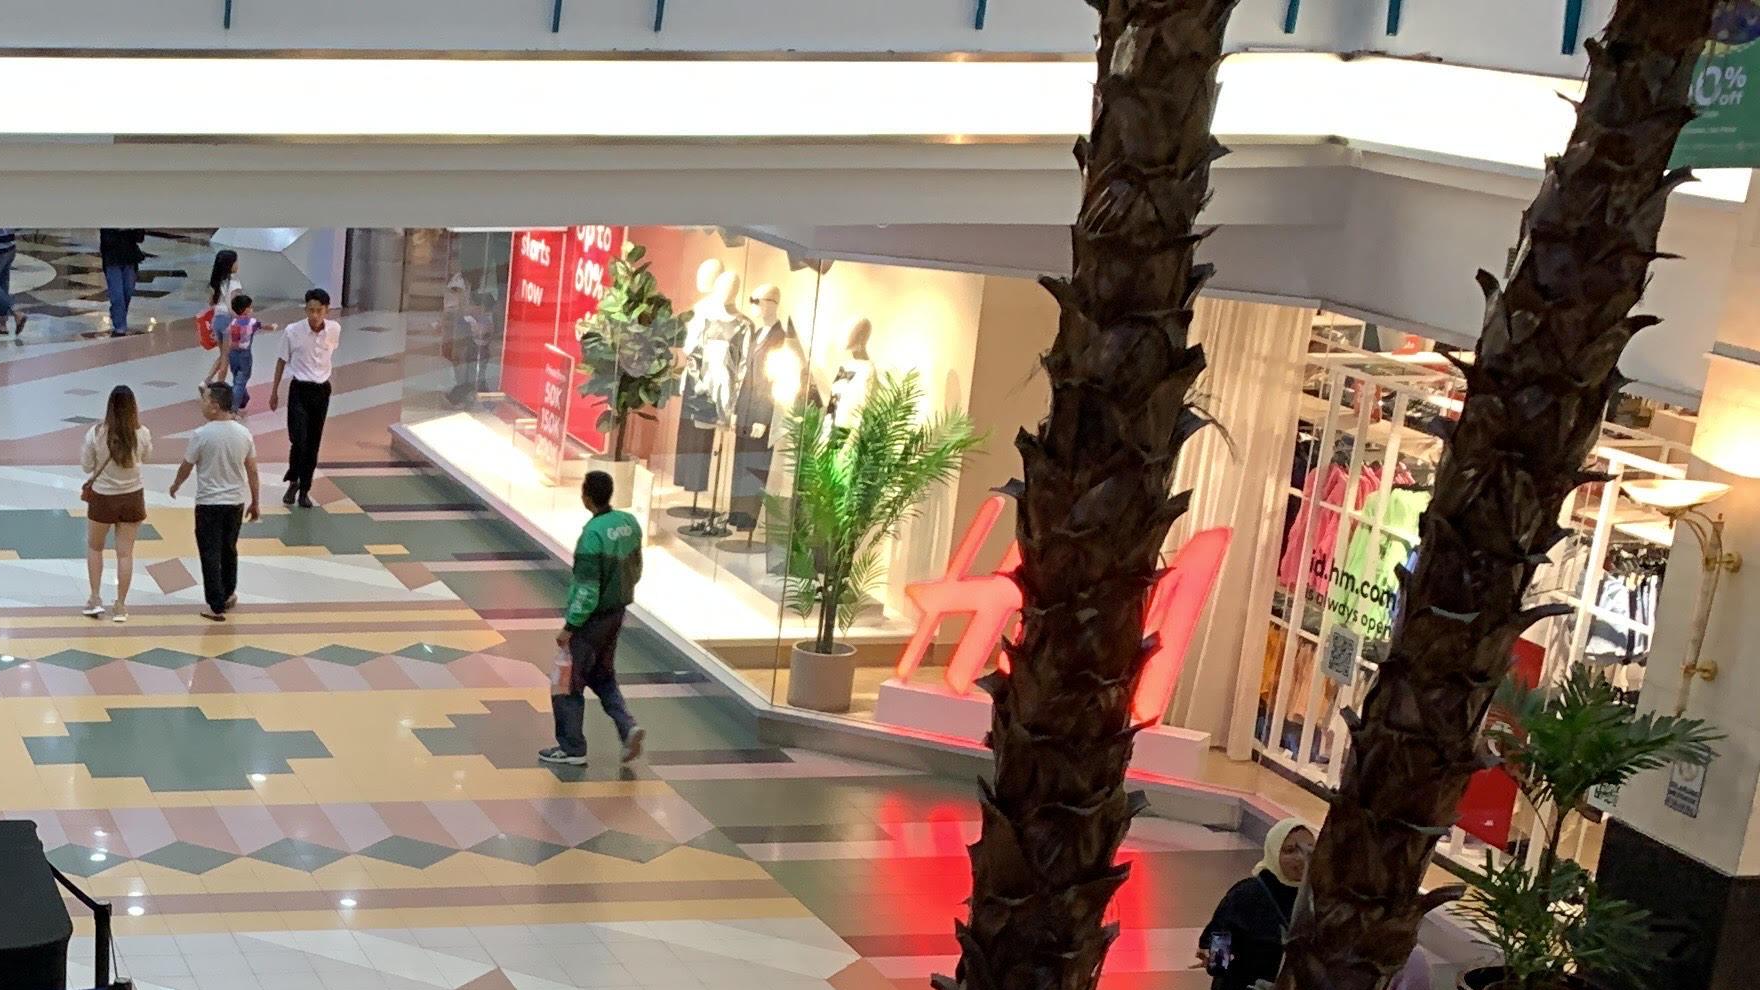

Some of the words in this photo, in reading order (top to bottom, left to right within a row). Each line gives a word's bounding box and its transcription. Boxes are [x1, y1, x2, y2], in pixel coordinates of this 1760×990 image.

[1688, 65, 1747, 107] 0%
[1720, 90, 1745, 106] off
[521, 231, 551, 267] starts
[521, 279, 544, 307] now
[575, 257, 605, 301] 60%
[1310, 548, 1397, 612] id.hm.com
[1361, 614, 1392, 638] open
